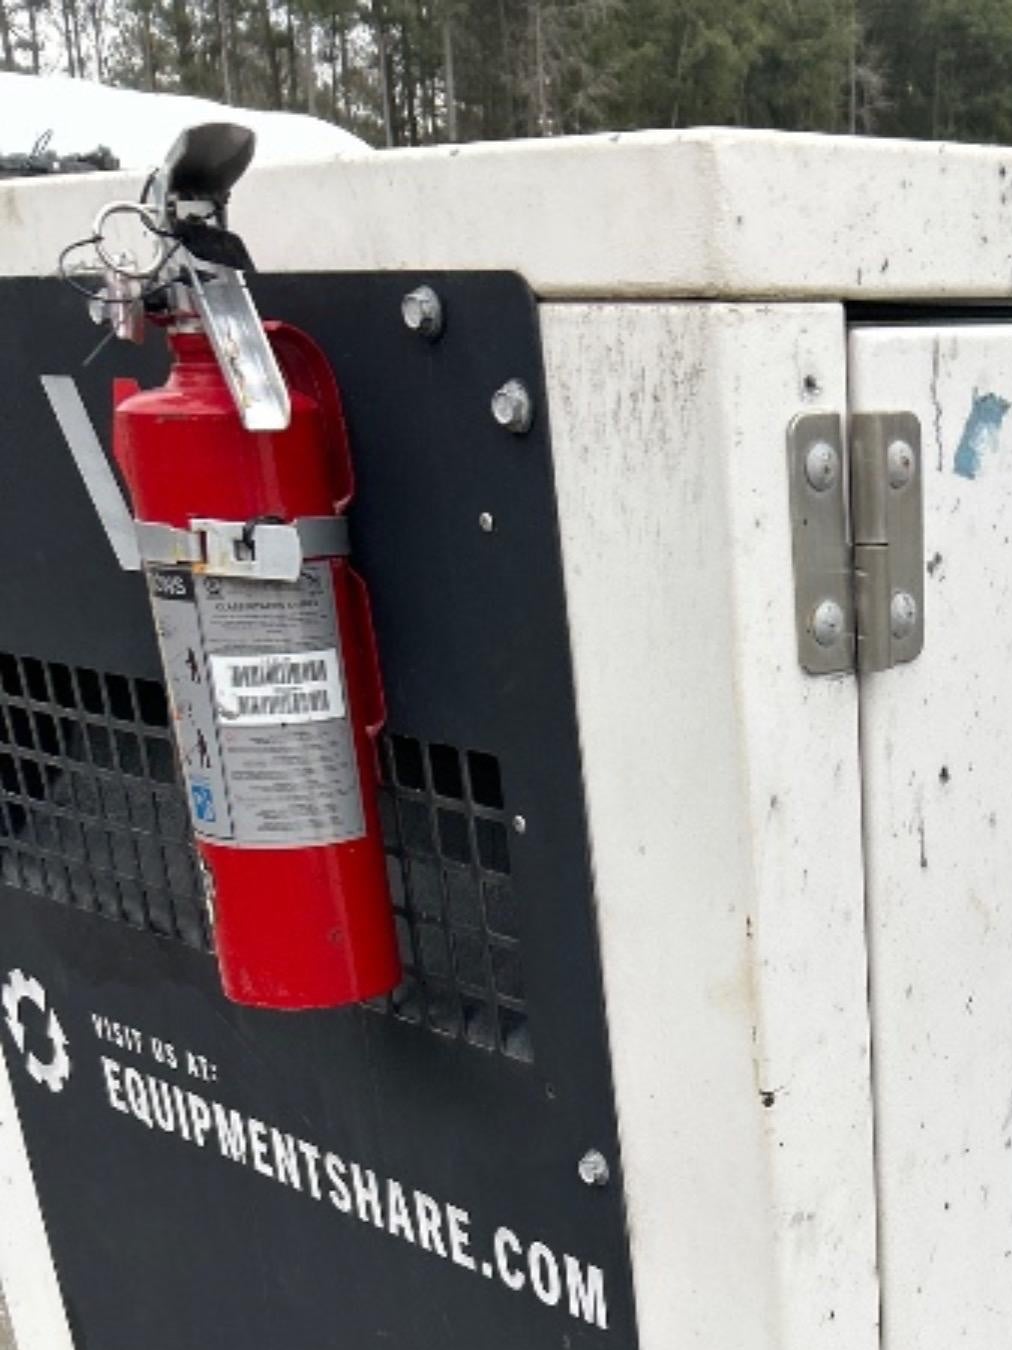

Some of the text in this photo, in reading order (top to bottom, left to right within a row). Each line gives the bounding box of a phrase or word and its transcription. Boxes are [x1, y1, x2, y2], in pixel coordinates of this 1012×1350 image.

[92, 1012, 217, 1081] VISIT US AT:
[100, 1055, 608, 1330] EQUIPMENTSHARE.COM
